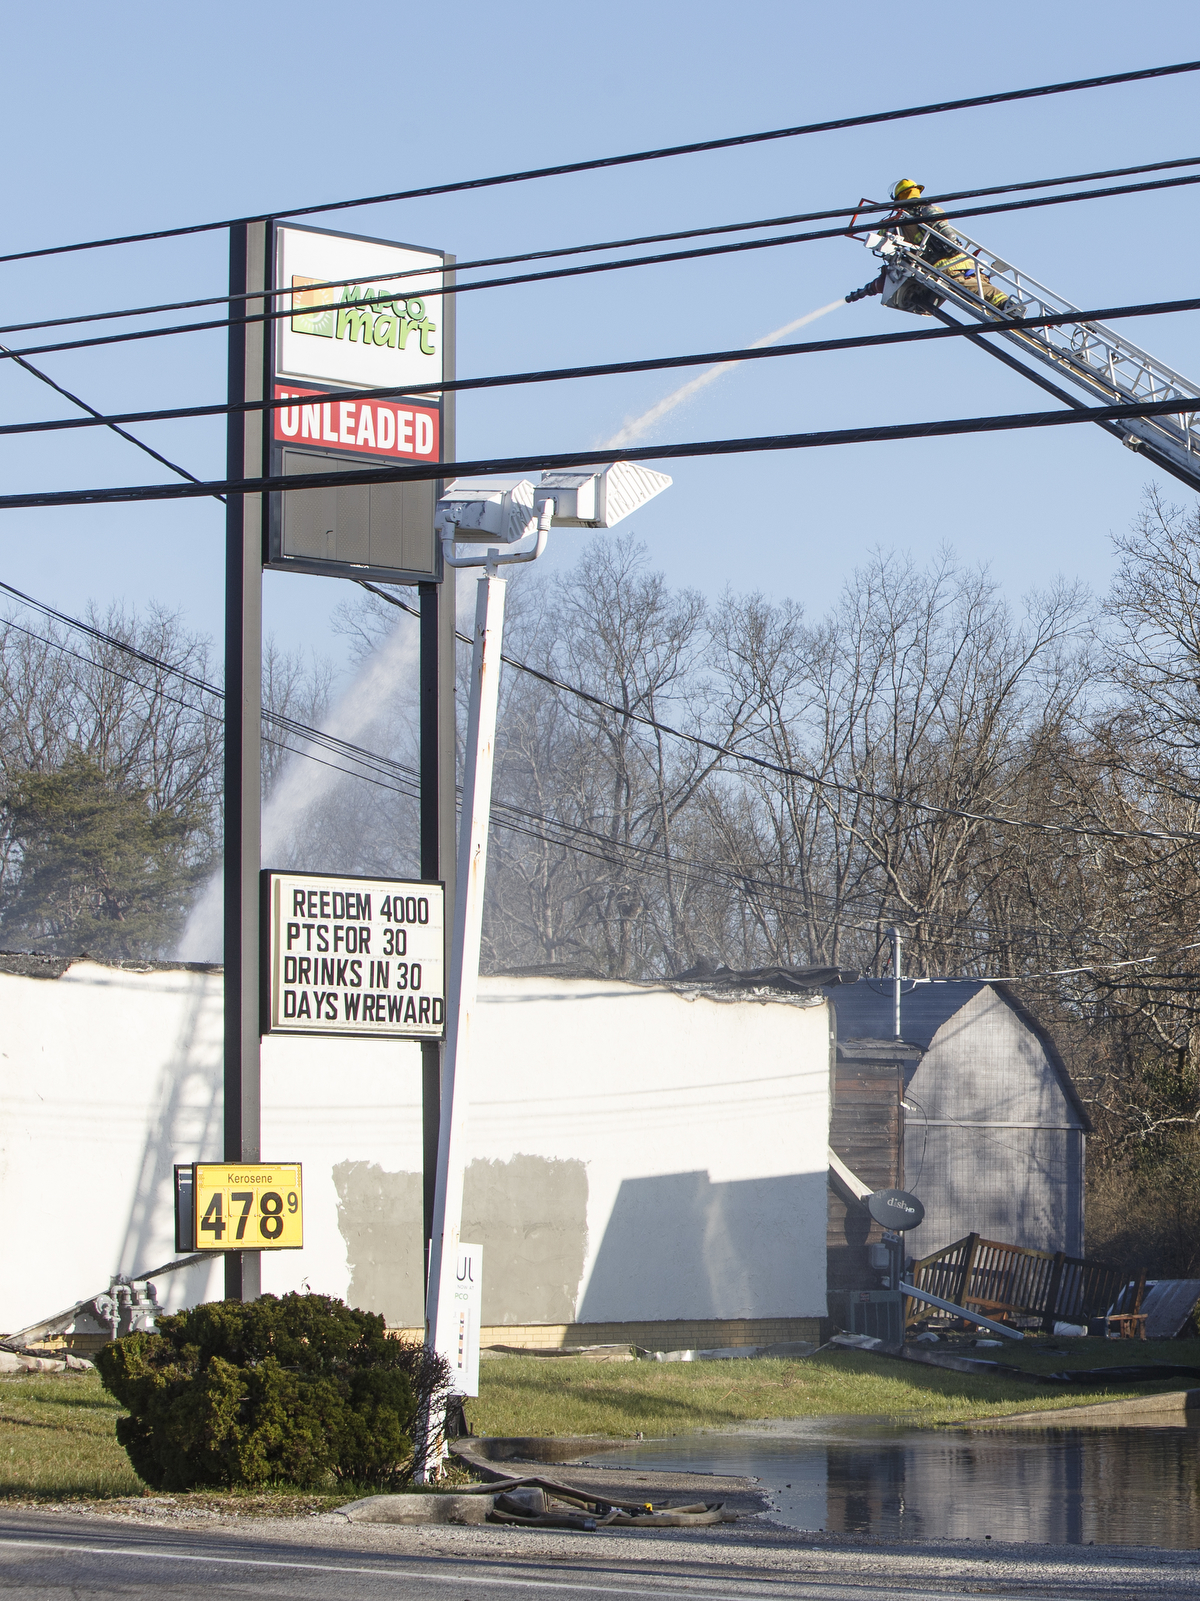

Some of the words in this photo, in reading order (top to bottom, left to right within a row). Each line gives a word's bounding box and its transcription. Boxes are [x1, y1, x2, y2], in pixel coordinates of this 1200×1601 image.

[339, 286, 426, 320] MAPCO
[335, 309, 437, 355] mart
[280, 392, 434, 455] UNLEADED
[293, 889, 372, 921] REEDEM
[380, 895, 429, 925] 4000
[287, 922, 329, 952] PTS
[333, 925, 371, 954] FOR
[383, 928, 407, 956] 30
[284, 956, 362, 987] DRINKS
[369, 961, 389, 988] IN
[397, 963, 422, 990] 30
[284, 990, 338, 1020] DAYS
[227, 1173, 273, 1183] Kerosene
[887, 1197, 907, 1209] dish
[454, 1292, 469, 1300] PCO
